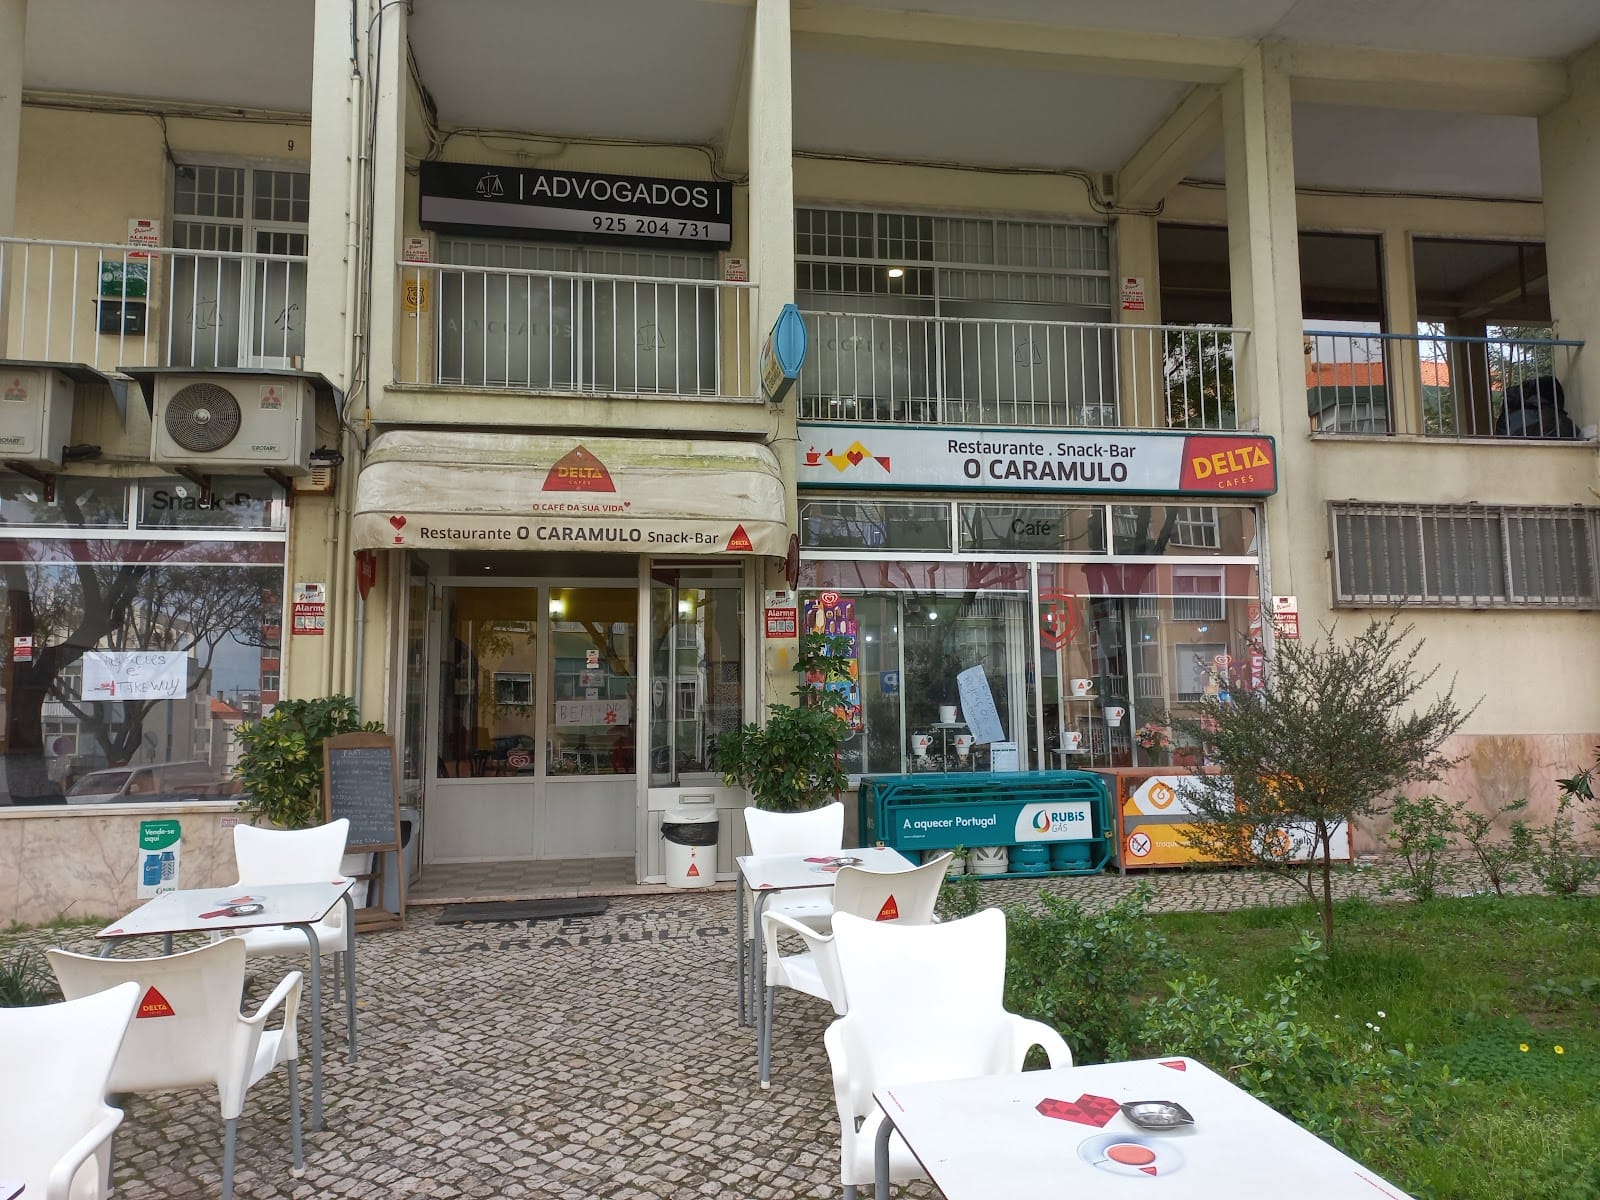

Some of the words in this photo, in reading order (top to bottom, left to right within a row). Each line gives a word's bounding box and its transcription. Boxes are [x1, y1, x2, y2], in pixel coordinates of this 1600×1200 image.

[532, 174, 709, 210] ADVOGADOS
[592, 215, 627, 232] 925
[636, 218, 670, 235] 204
[679, 221, 711, 239] 731
[947, 439, 1045, 457] Restaurante
[1056, 443, 1137, 458] Snack-Bar
[558, 466, 603, 479] DELTA
[963, 458, 981, 479] O
[989, 459, 1129, 483] CARAMULO
[1191, 446, 1272, 480] DELTA
[532, 503, 540, 511] O
[582, 504, 600, 512] SUA
[602, 504, 625, 512] VIDA
[420, 525, 511, 541] Restaurante
[517, 526, 530, 541] O
[536, 527, 642, 543] CARAMULO
[648, 531, 719, 545] Snack-Bar
[1011, 517, 1051, 537] Café
[767, 609, 795, 617] Alarme
[145, 828, 175, 836] Vende-se
[903, 818, 912, 829] A
[914, 818, 953, 831] aquecer
[955, 814, 997, 829] Portugal
[142, 1004, 168, 1012] DELTA
